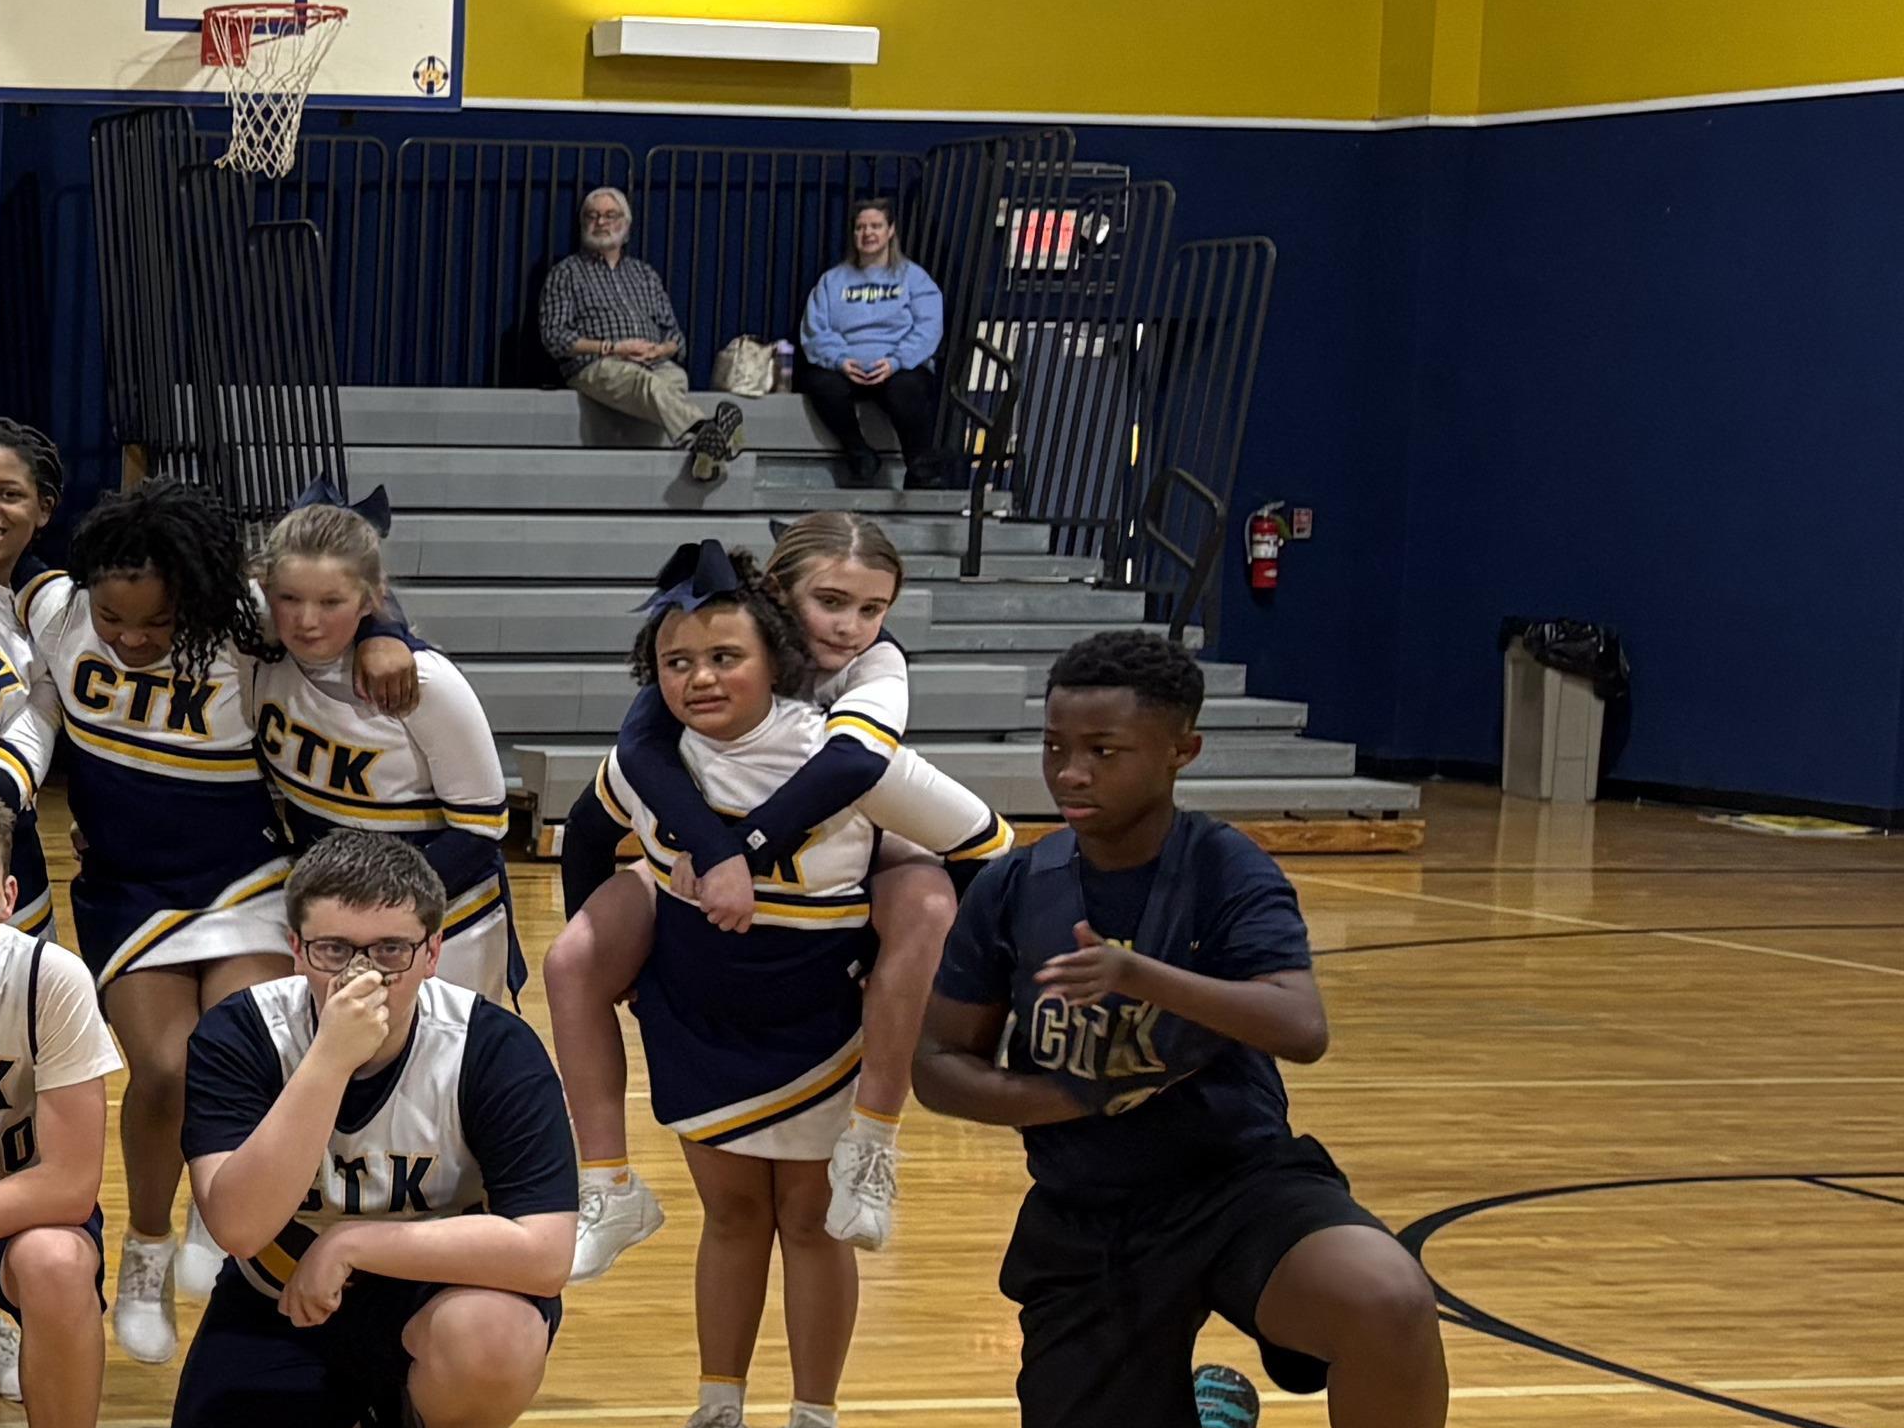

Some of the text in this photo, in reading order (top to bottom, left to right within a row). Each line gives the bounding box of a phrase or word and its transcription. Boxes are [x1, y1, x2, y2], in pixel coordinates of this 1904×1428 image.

[73, 654, 221, 738] CTK
[258, 702, 382, 799] CTK
[0, 1115, 36, 1173] 0
[298, 1153, 437, 1215] TK
